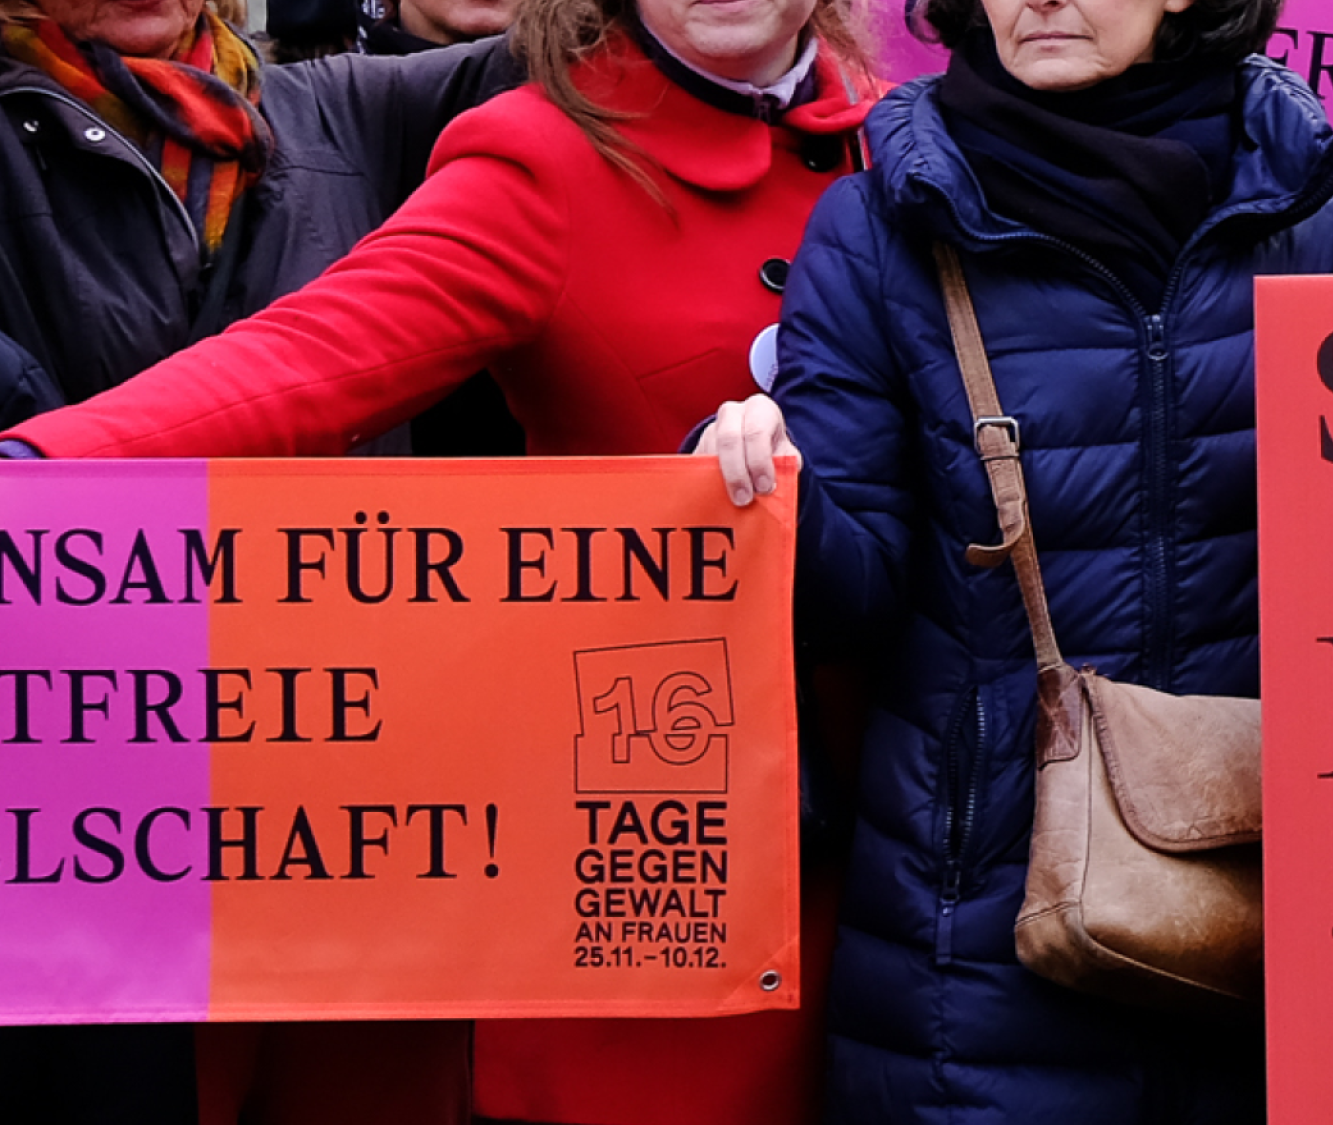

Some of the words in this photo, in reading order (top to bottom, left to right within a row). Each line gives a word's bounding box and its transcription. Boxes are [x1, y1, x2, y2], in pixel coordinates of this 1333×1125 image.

[277, 511, 471, 605] FÜR
[499, 525, 741, 606] EINE
[0, 667, 383, 745] TFREIE
[592, 672, 716, 765] 16
[4, 802, 501, 885] LSCHAFT!
[575, 801, 728, 846] TAGE
[573, 848, 728, 885] GEGEN
[573, 889, 727, 919] GEWALT
[575, 922, 613, 944] AN
[621, 922, 728, 944] FRAUEN
